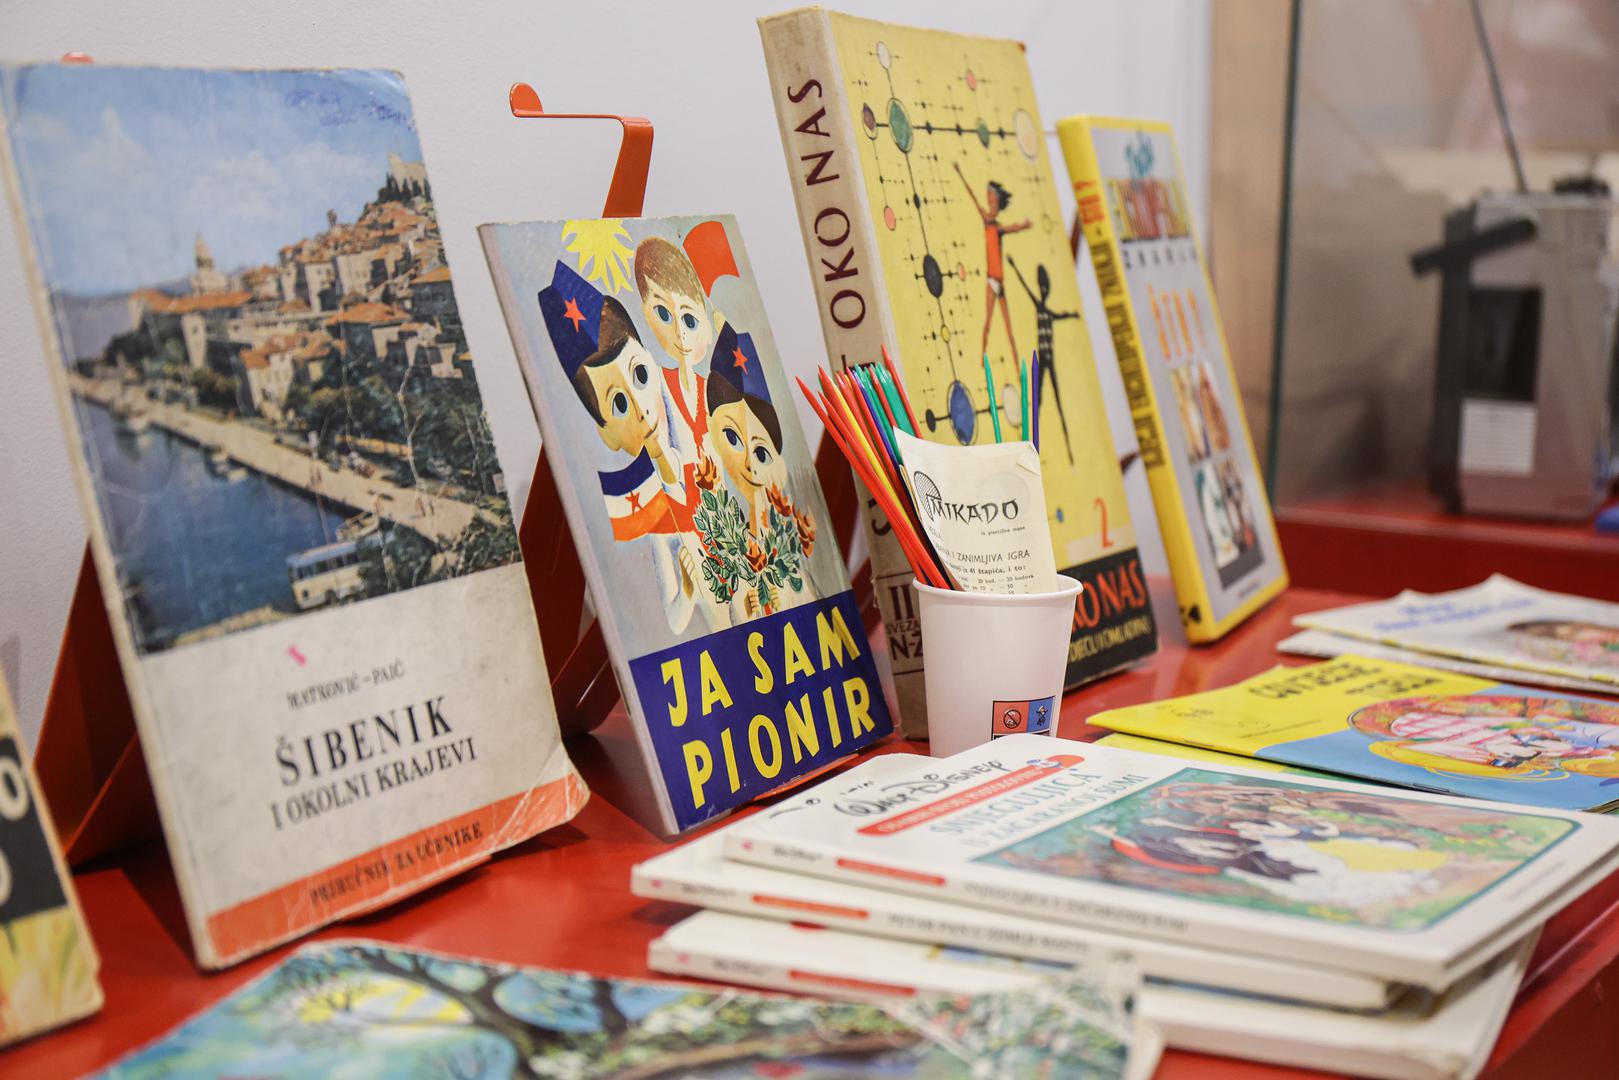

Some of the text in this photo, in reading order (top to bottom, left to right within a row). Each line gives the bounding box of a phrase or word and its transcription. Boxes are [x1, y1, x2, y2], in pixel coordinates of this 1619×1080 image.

[787, 78, 866, 330] OKO NAS
[931, 498, 1019, 525] MIKADO
[1094, 496, 1114, 548] 2
[957, 552, 1003, 565] ZANIMLJIVA
[1008, 549, 1031, 561] IGRA
[1097, 559, 1148, 617] NAS
[886, 619, 921, 634] SVEZA
[889, 583, 915, 621] II
[660, 606, 861, 727] JA SAM
[276, 696, 453, 787] ŠIBENIK
[682, 677, 876, 810] PIONIR
[270, 736, 478, 831] I OKOLNI KRAJEVI
[309, 821, 483, 907] PRIRUČNIK ZA UČENIKE
